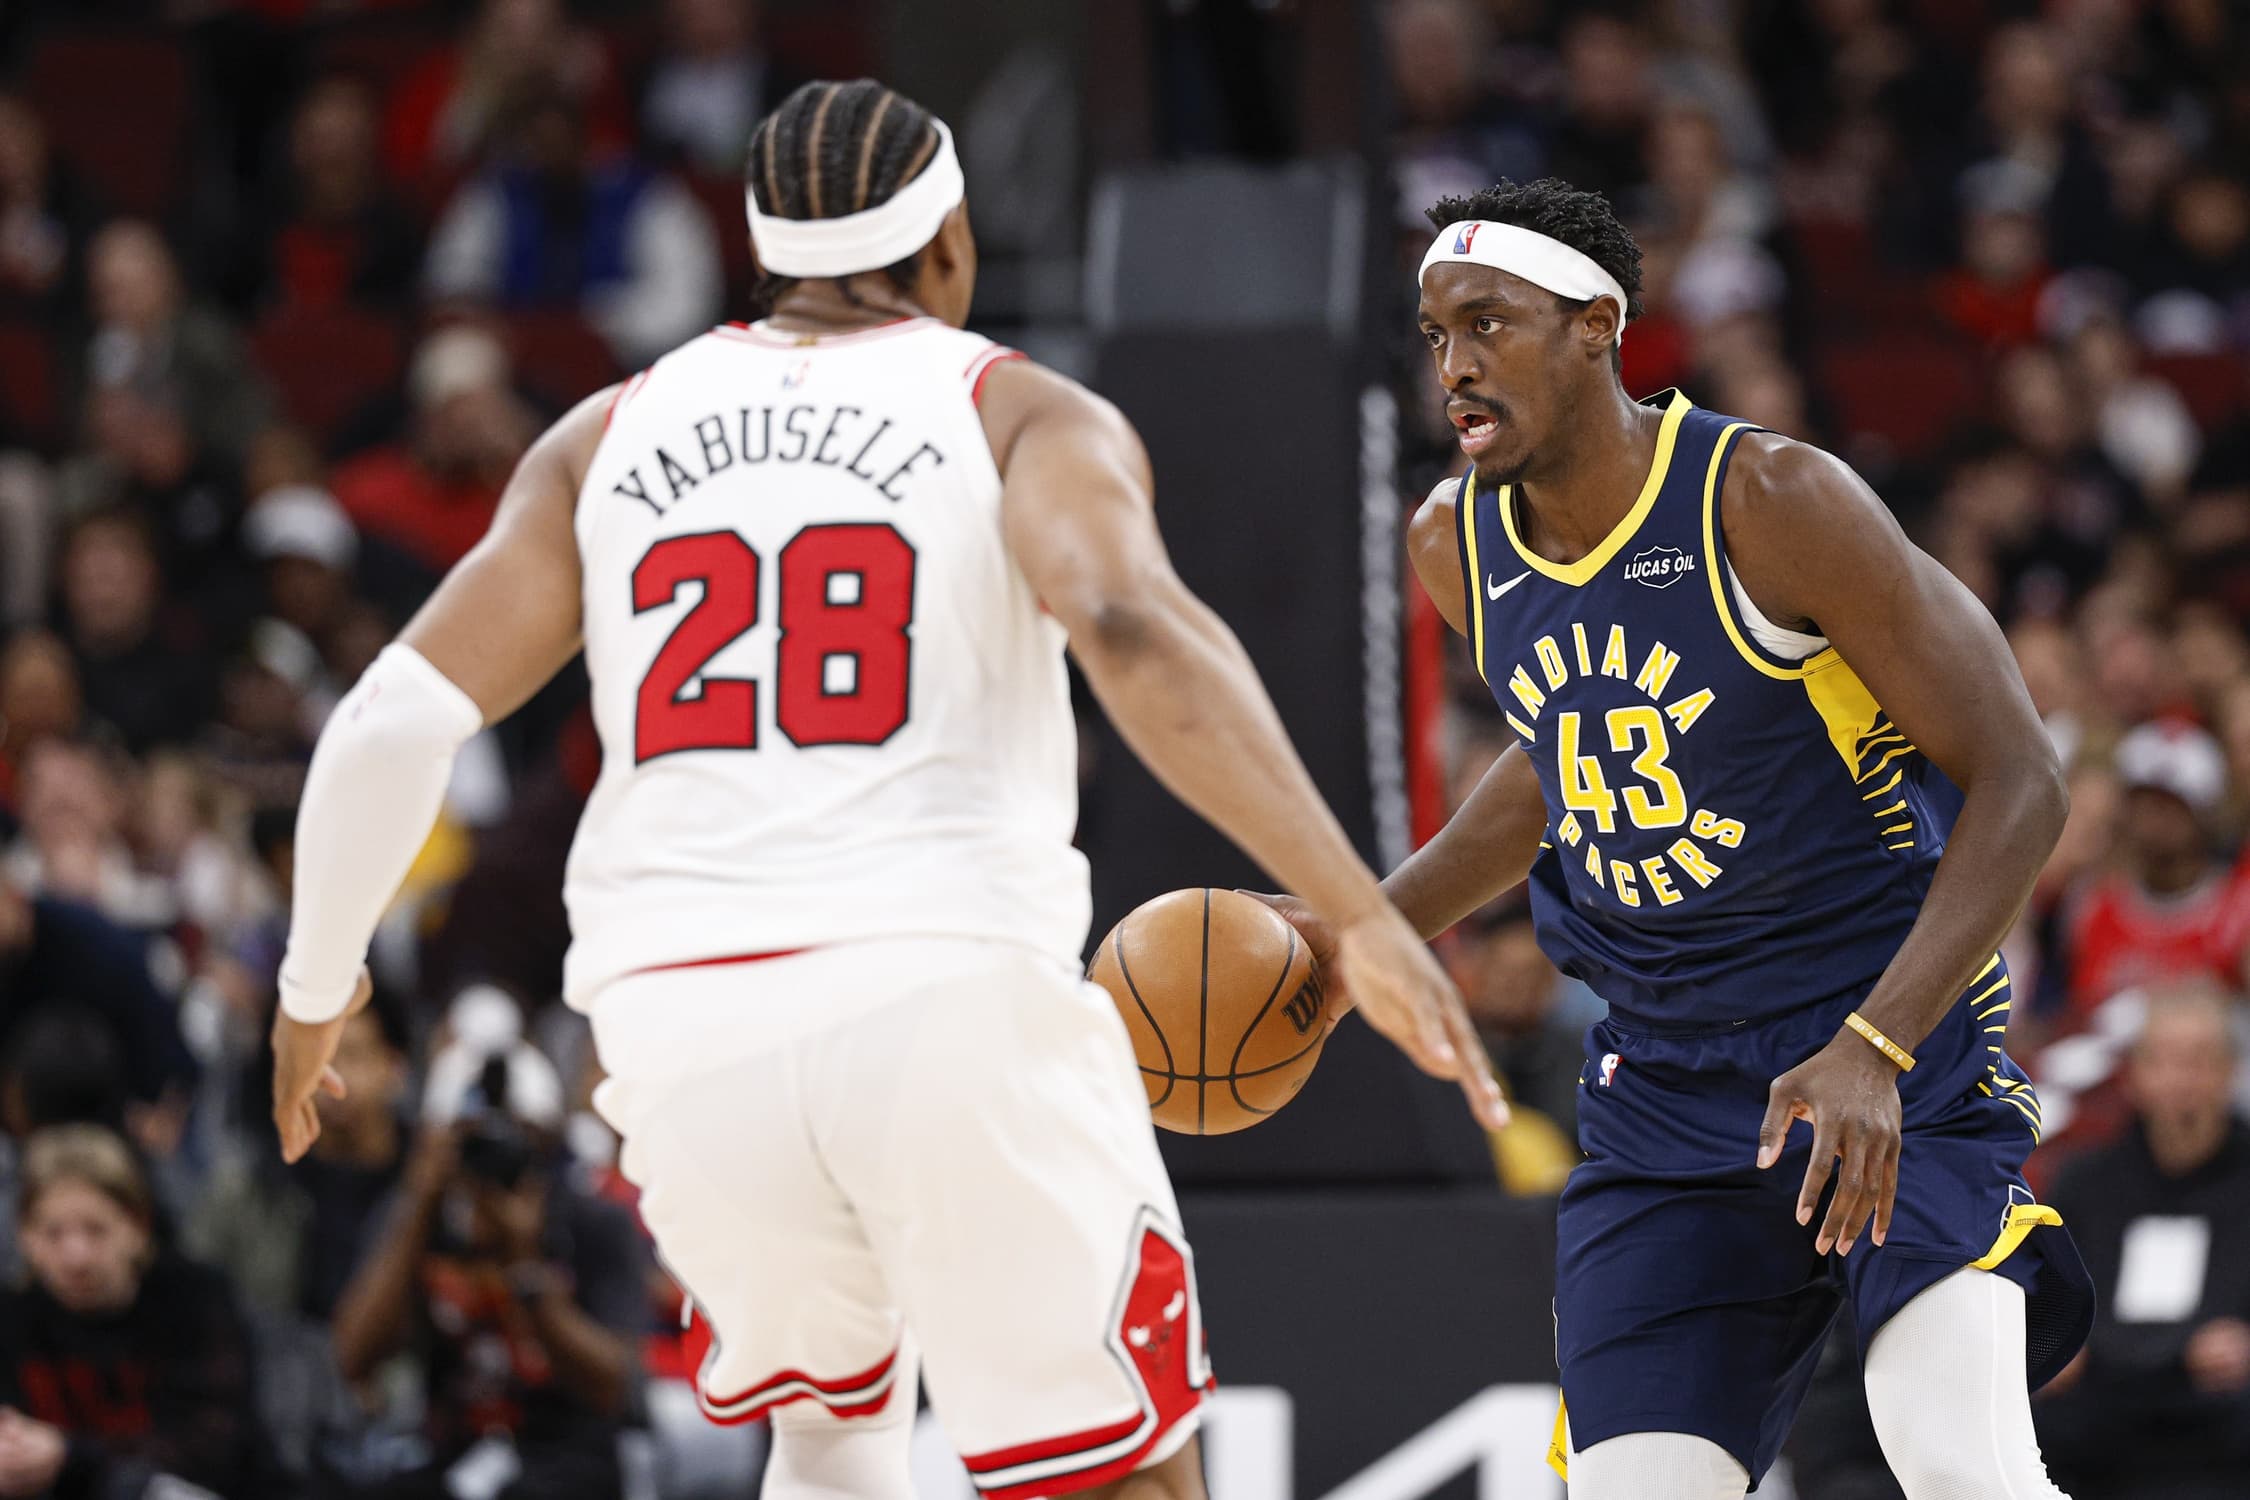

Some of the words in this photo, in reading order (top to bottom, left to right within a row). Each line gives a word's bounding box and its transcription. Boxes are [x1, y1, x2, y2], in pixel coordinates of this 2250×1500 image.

[612, 405, 945, 518] YABUSELE
[1623, 558, 1671, 580] LUCAS
[1674, 554, 1695, 573] OIL
[631, 522, 917, 768] 28
[1505, 622, 1717, 744] INDIANA
[1558, 705, 1688, 834] 43
[1557, 808, 1746, 908] PACERS
